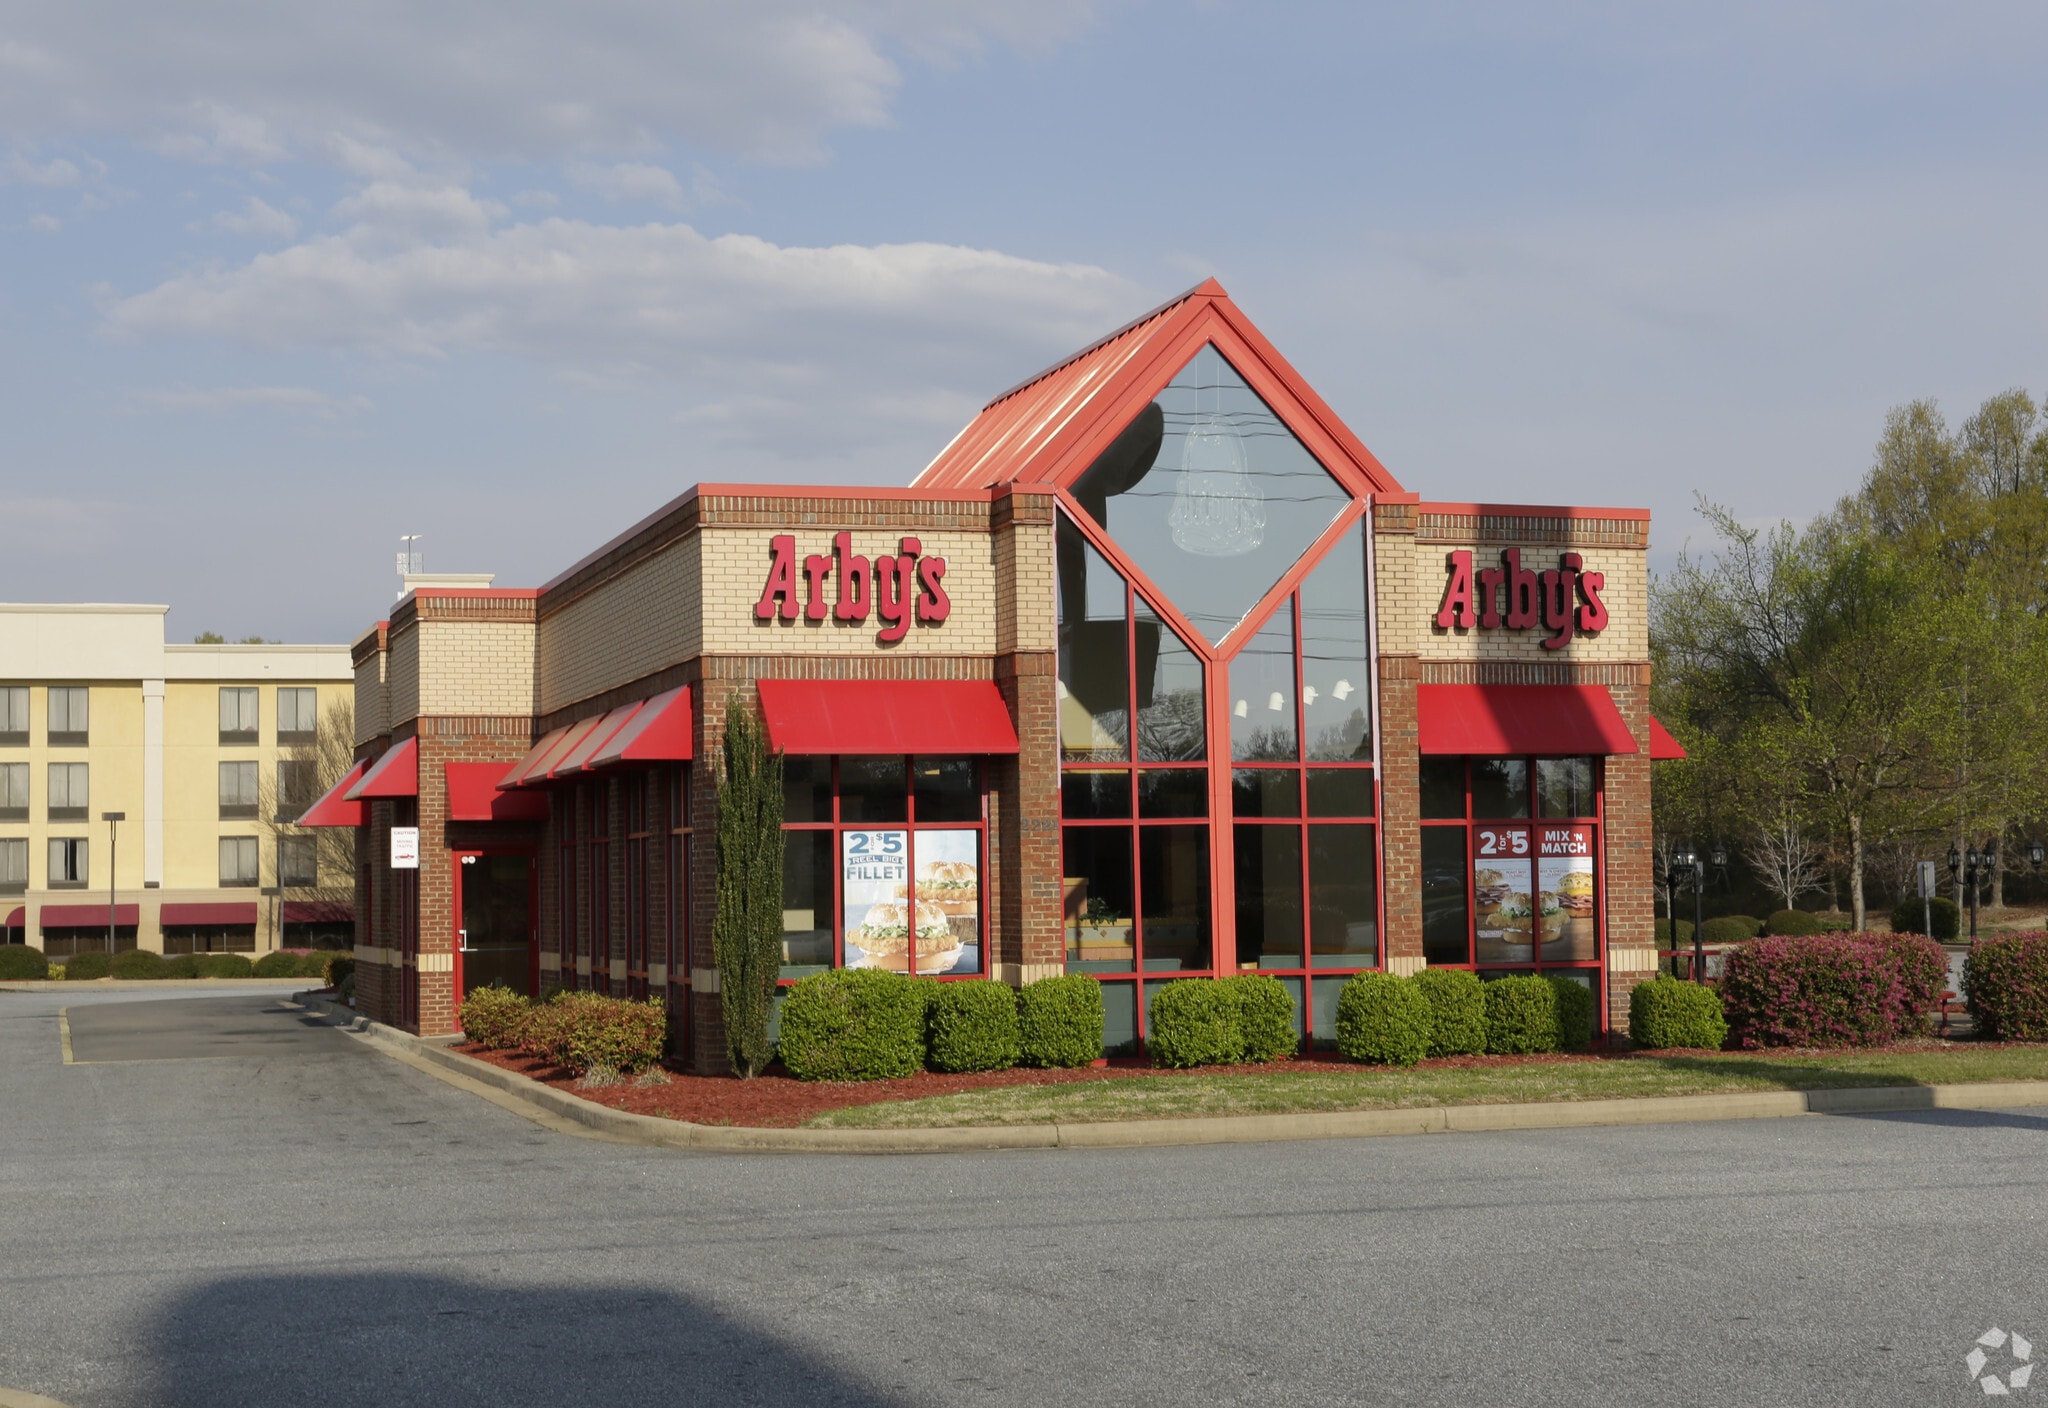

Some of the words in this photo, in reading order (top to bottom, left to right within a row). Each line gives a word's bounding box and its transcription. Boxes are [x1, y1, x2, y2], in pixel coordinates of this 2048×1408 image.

[756, 531, 951, 641] Arby's
[1437, 547, 1609, 649] Arby's
[849, 833, 869, 854] 2
[1480, 831, 1497, 854] 2
[1506, 830, 1529, 854] $5
[1545, 830, 1570, 841] MIX
[1541, 842, 1587, 854] MATCH
[852, 856, 879, 864] REEL
[846, 866, 905, 880] FILLET
